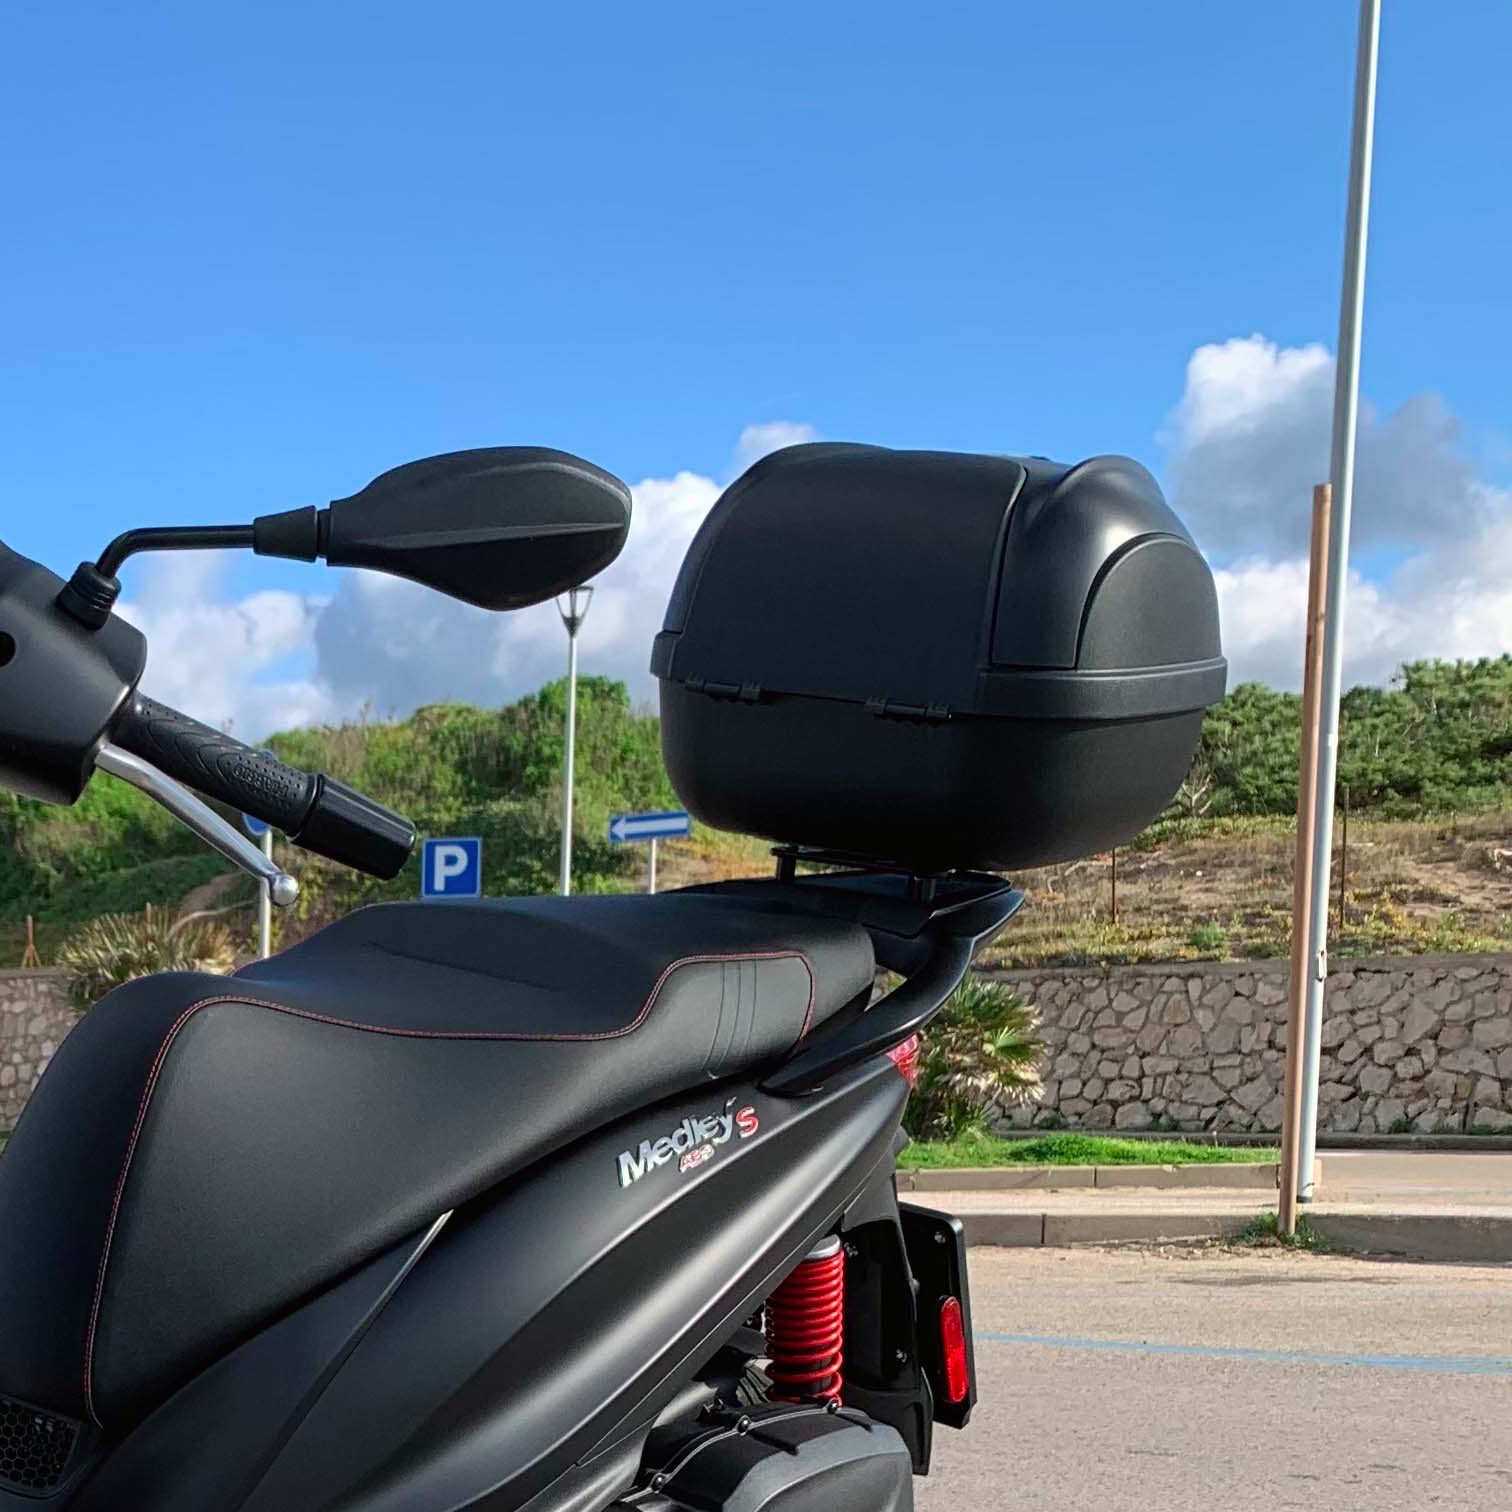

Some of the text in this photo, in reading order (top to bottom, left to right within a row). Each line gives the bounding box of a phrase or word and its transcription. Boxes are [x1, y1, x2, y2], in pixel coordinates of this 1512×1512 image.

[434, 845, 469, 892] P
[616, 1097, 759, 1188] Medley S
